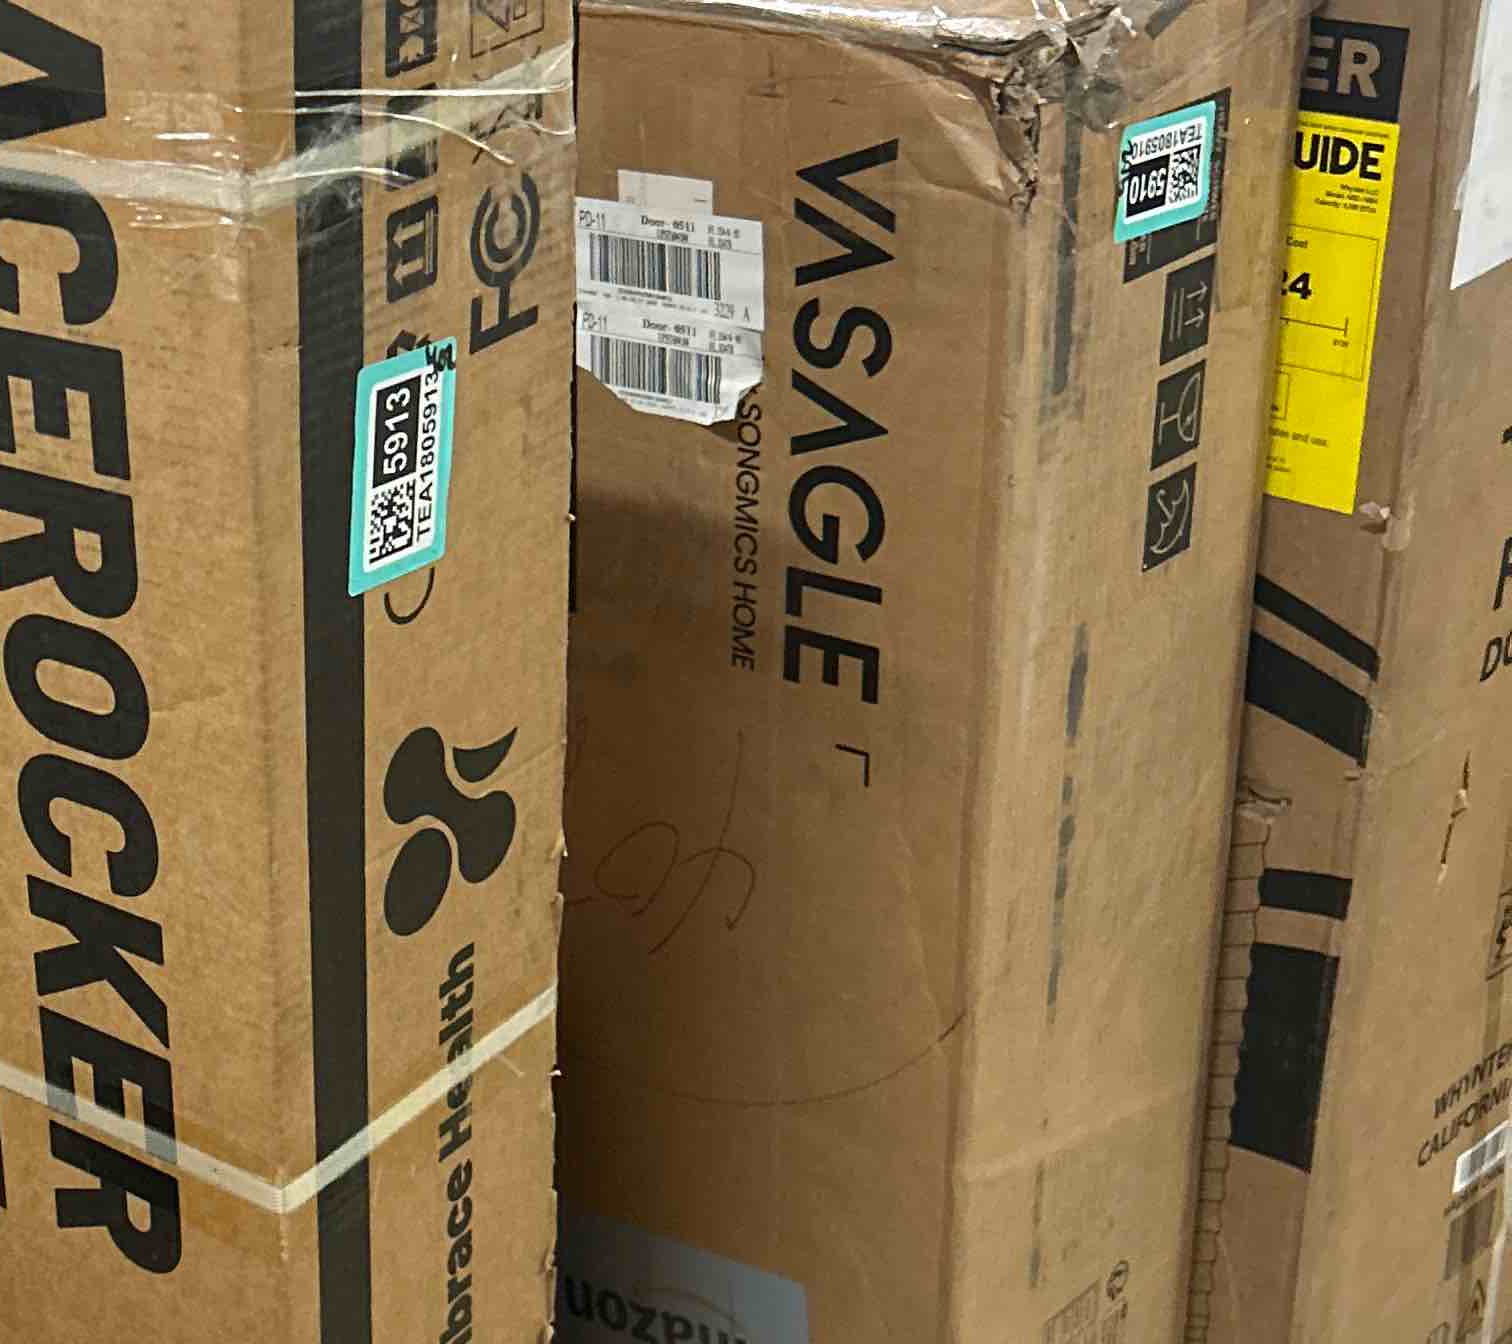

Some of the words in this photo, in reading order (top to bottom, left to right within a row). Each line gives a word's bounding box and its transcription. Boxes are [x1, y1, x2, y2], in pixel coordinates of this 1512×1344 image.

[1301, 34, 1382, 99] ER
[1127, 175, 1168, 209] 5910
[1293, 130, 1385, 182] UIDE
[383, 385, 412, 476] 5913
[415, 370, 440, 544] TEA1805913
[781, 138, 900, 705] VASAGLE
[732, 402, 763, 576] SONGMICS
[730, 580, 759, 671] HOME
[438, 940, 475, 1163] Health
